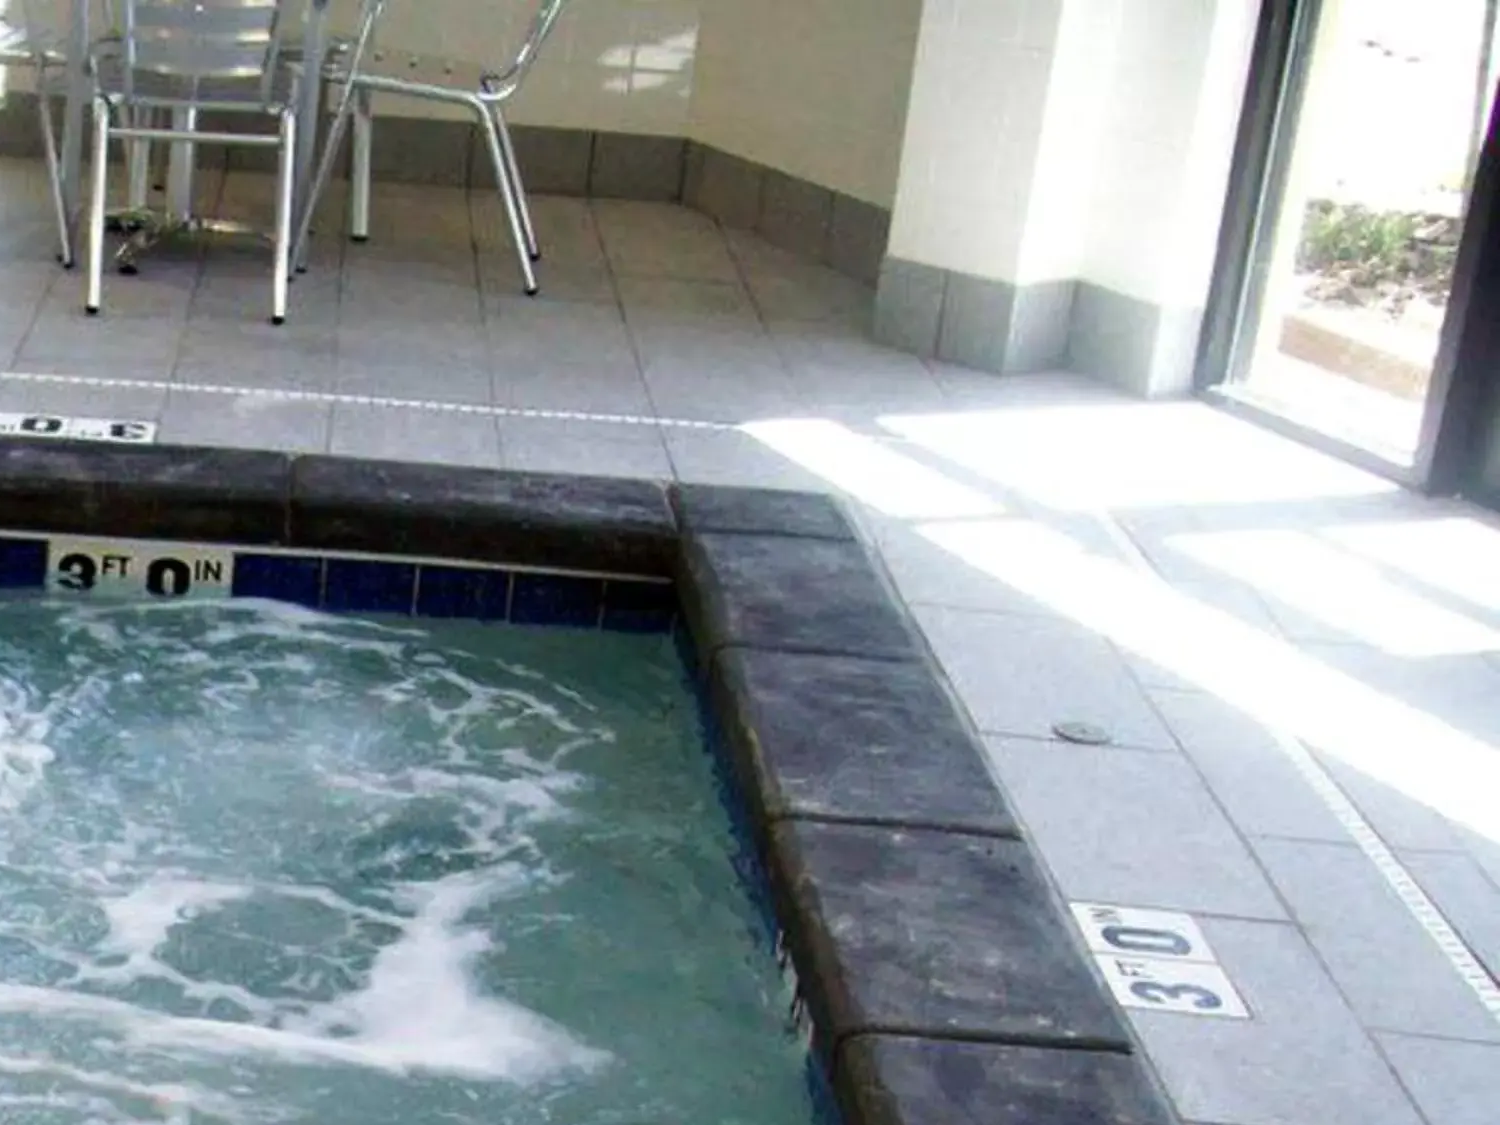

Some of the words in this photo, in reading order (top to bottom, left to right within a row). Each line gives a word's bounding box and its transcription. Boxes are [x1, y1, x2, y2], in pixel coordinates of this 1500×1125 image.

[102, 555, 132, 578] FT
[146, 557, 191, 597] 0
[195, 560, 222, 582] IN
[1101, 925, 1192, 956] 0
[1129, 981, 1223, 1009] 3
